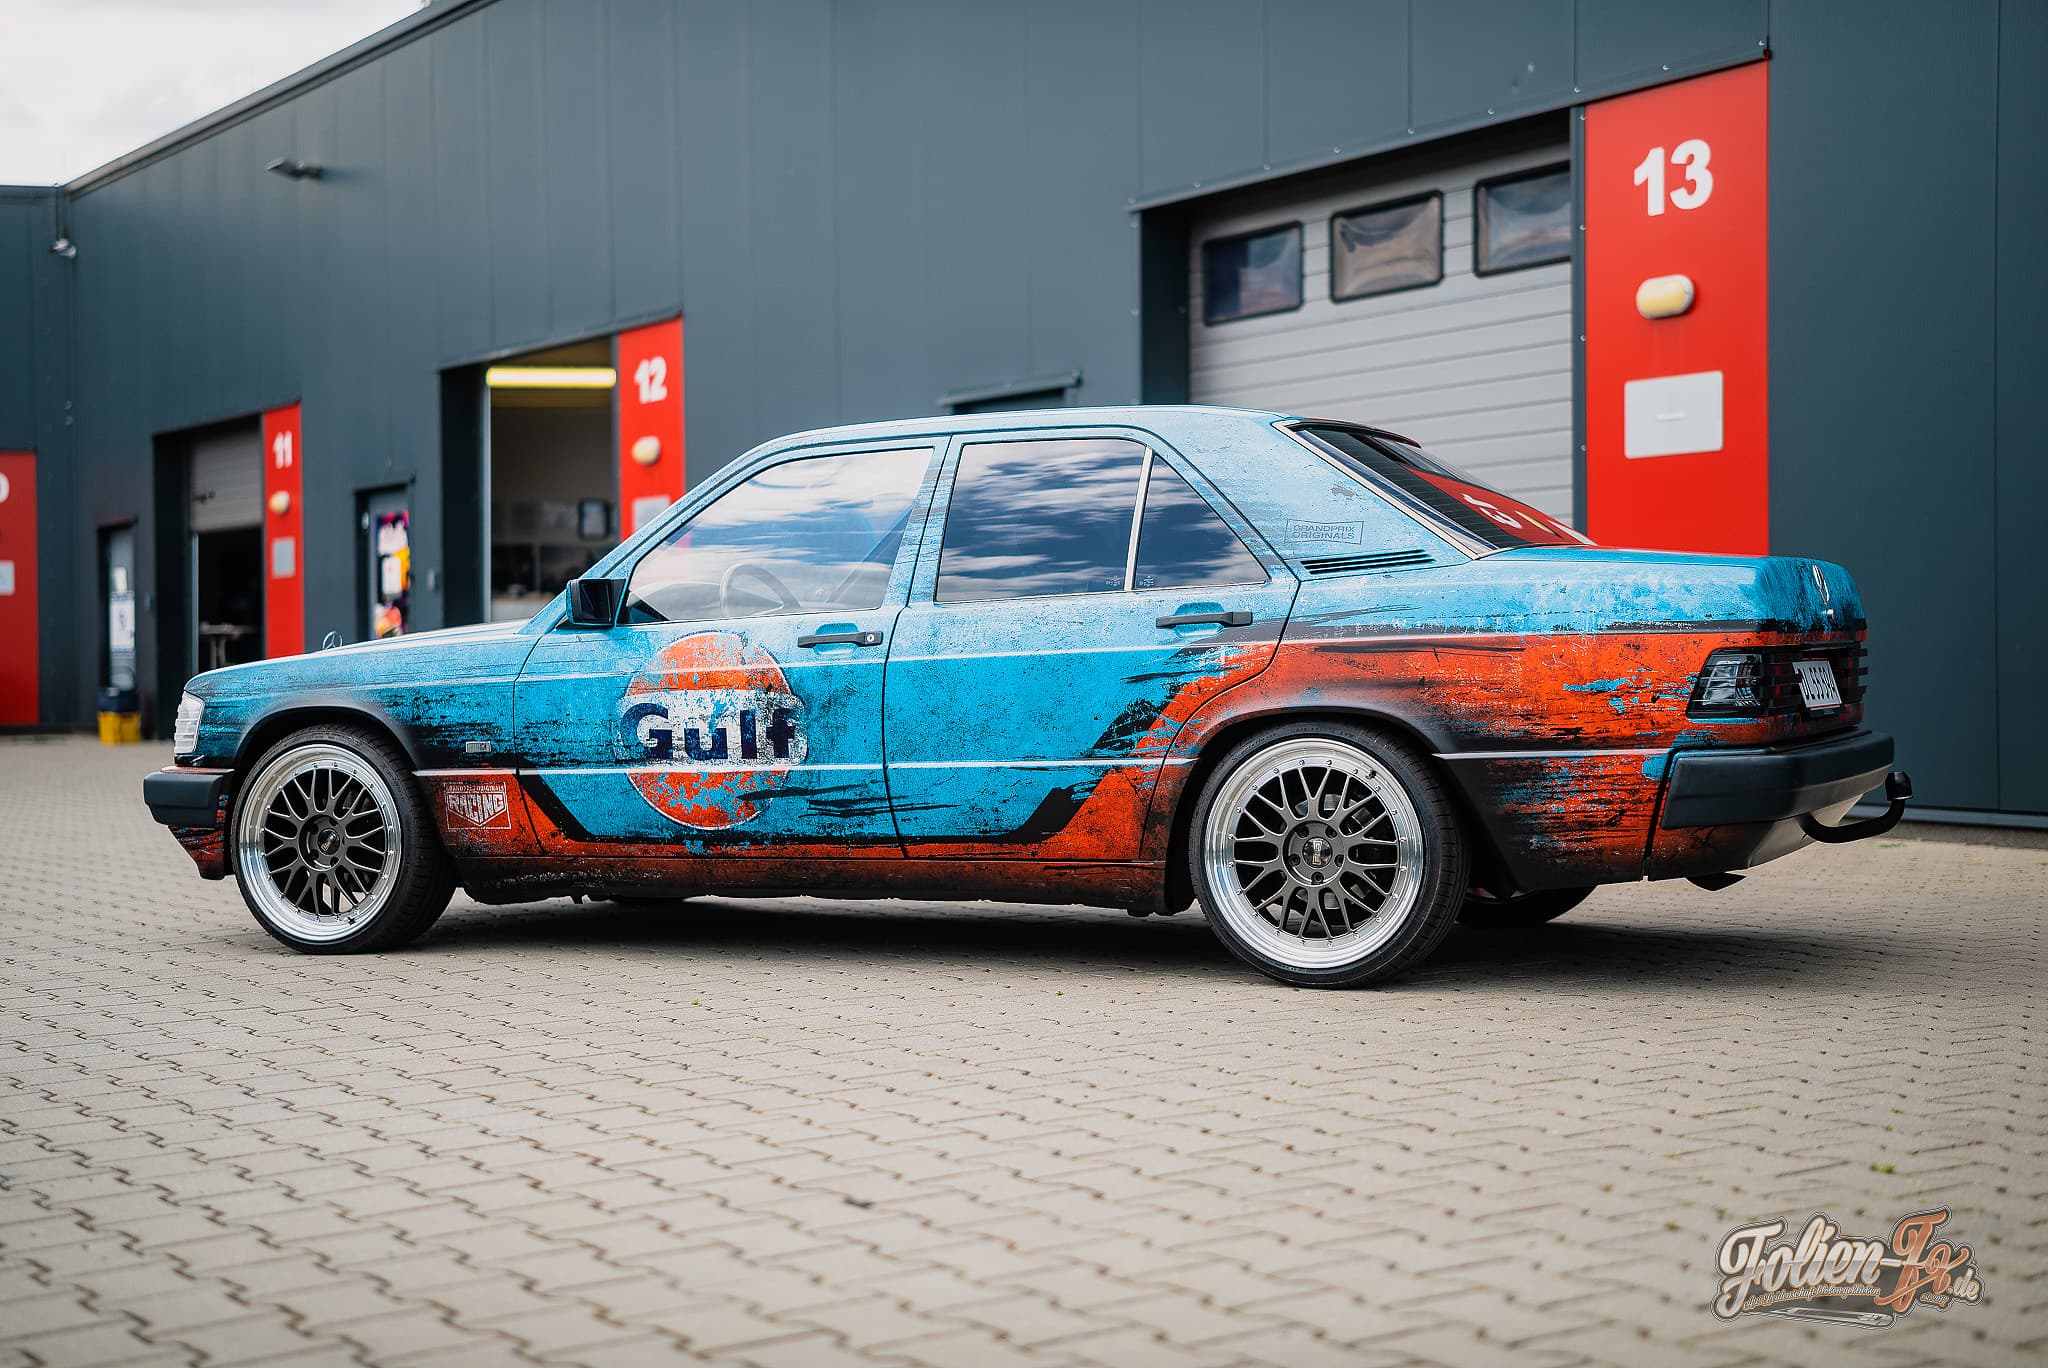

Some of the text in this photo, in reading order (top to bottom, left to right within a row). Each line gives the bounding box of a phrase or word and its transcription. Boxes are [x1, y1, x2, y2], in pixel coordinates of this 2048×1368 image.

[1633, 138, 1714, 217] 13
[634, 356, 669, 405] 12
[272, 430, 294, 469] 11
[1292, 532, 1355, 540] ORIGINALS
[1293, 524, 1355, 532] GRANDPRIX
[617, 702, 798, 761] Gulf
[448, 793, 505, 823] RACING
